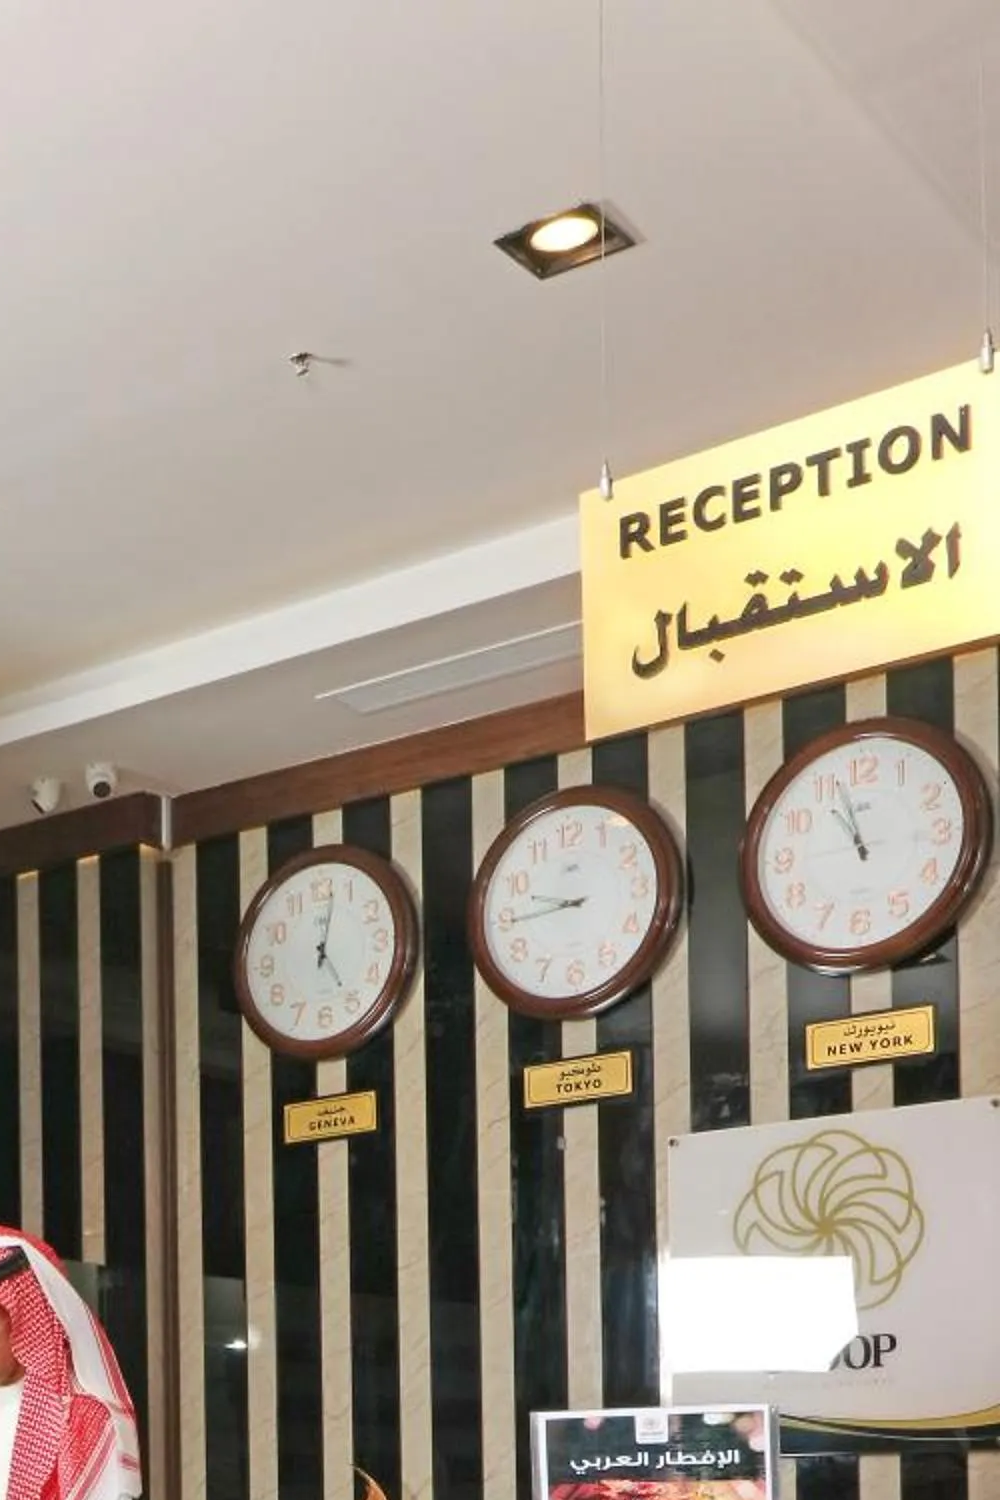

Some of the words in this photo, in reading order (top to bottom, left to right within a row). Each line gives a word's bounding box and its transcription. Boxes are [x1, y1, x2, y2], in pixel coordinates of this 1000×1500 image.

[618, 403, 973, 560] RECEPTION
[631, 520, 962, 680] الاستقبال
[849, 754, 879, 787] 12
[896, 759, 905, 787] 1
[813, 773, 835, 801] 11
[920, 782, 941, 811] 2
[557, 820, 583, 849] 12
[596, 821, 607, 849] 1
[785, 808, 813, 835] 10
[931, 818, 952, 845] 3
[528, 838, 548, 864] 11
[619, 844, 638, 870] 2
[774, 847, 794, 874] 9
[507, 870, 530, 897] 10
[920, 857, 938, 885] 4
[631, 874, 648, 898] 3
[786, 881, 806, 909] 8
[812, 902, 835, 931] 7
[887, 890, 910, 918] 5
[498, 907, 515, 932] 9
[622, 911, 640, 934] 4
[850, 908, 871, 936] 6
[510, 938, 528, 963] 8
[598, 941, 616, 968] 5
[535, 958, 552, 983] 7
[566, 959, 584, 986] 6
[826, 1041, 864, 1057] NEW
[869, 1034, 914, 1051] YORK
[555, 1079, 603, 1094] TOKYO
[308, 1115, 356, 1132] GENEVA
[829, 1333, 897, 1371] OP
[569, 1449, 649, 1476] العربي
[655, 1448, 740, 1470] الإفطار
